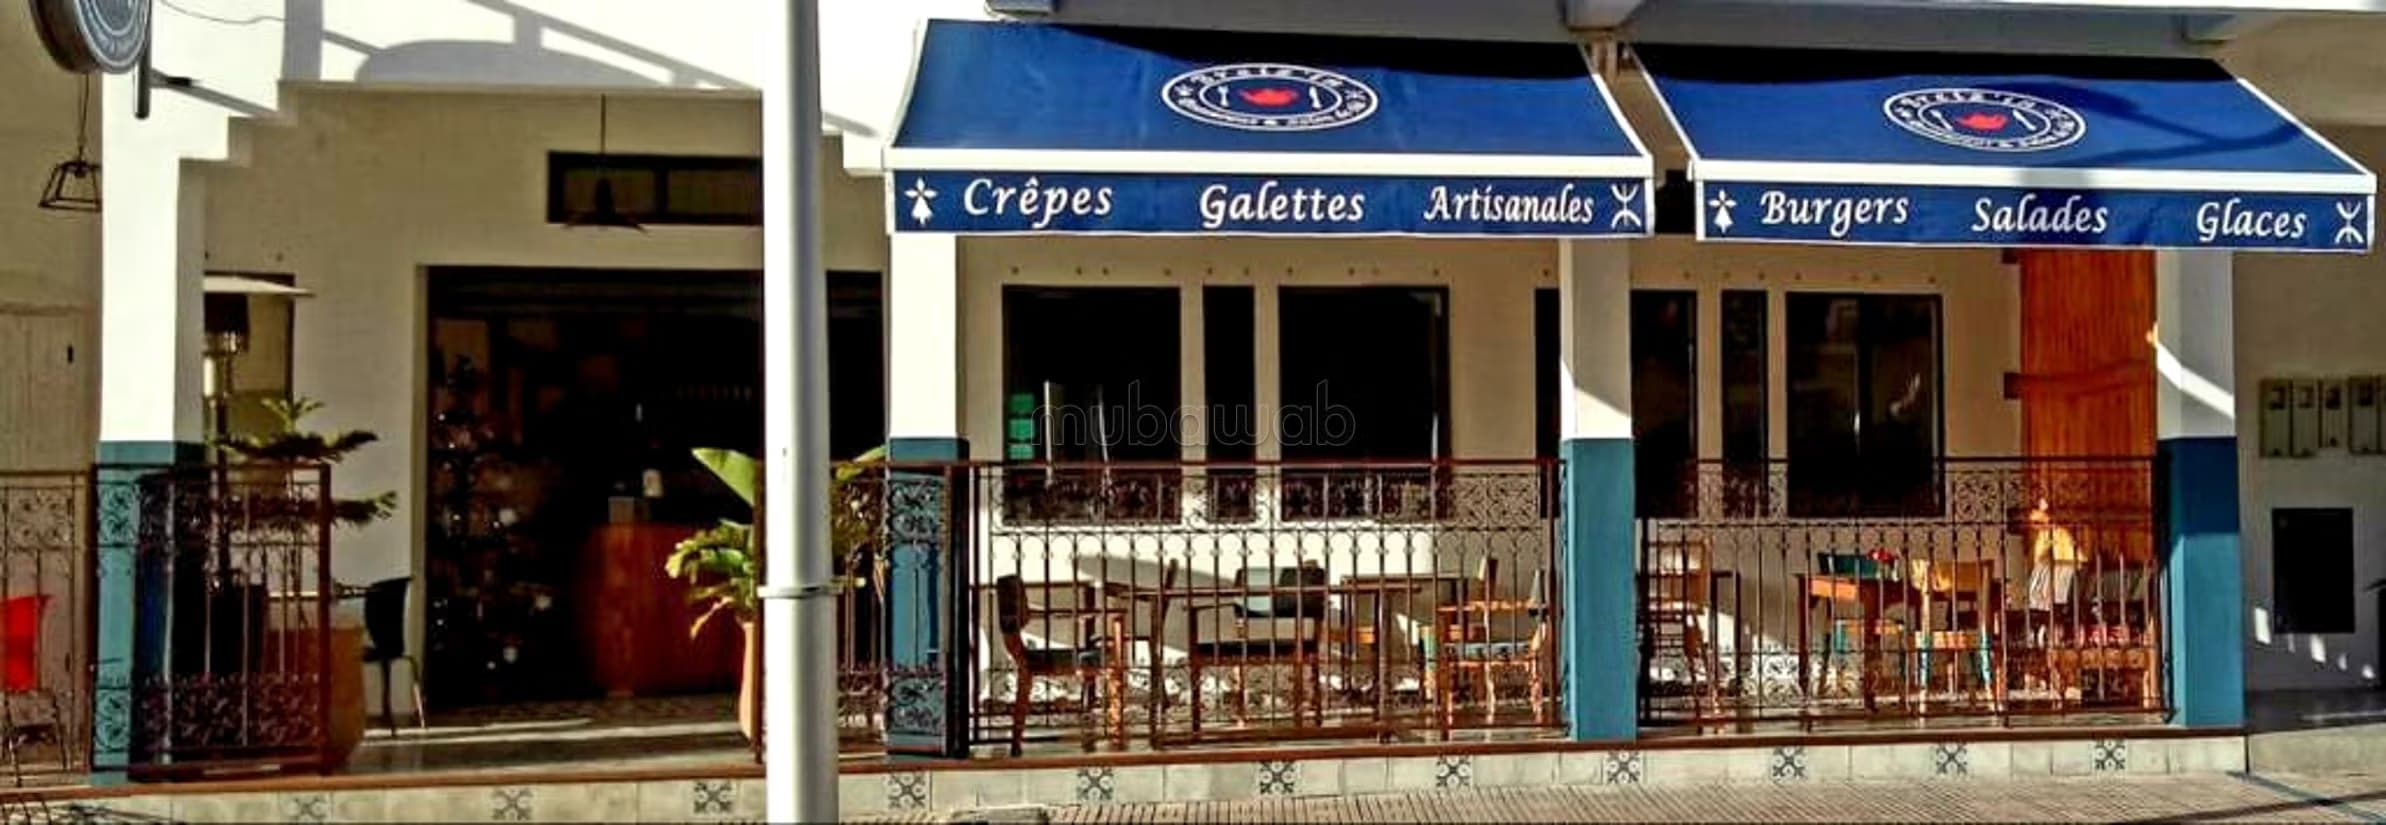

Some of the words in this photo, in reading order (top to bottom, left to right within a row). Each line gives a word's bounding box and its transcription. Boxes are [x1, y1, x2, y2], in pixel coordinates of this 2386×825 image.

[962, 175, 1114, 231] Crêpes
[1198, 180, 1366, 230] Galettes
[1422, 183, 1595, 224] Artisanales
[1759, 189, 1910, 238] Burgers
[1970, 193, 2109, 233] Salades
[2195, 197, 2308, 243] Glaces
